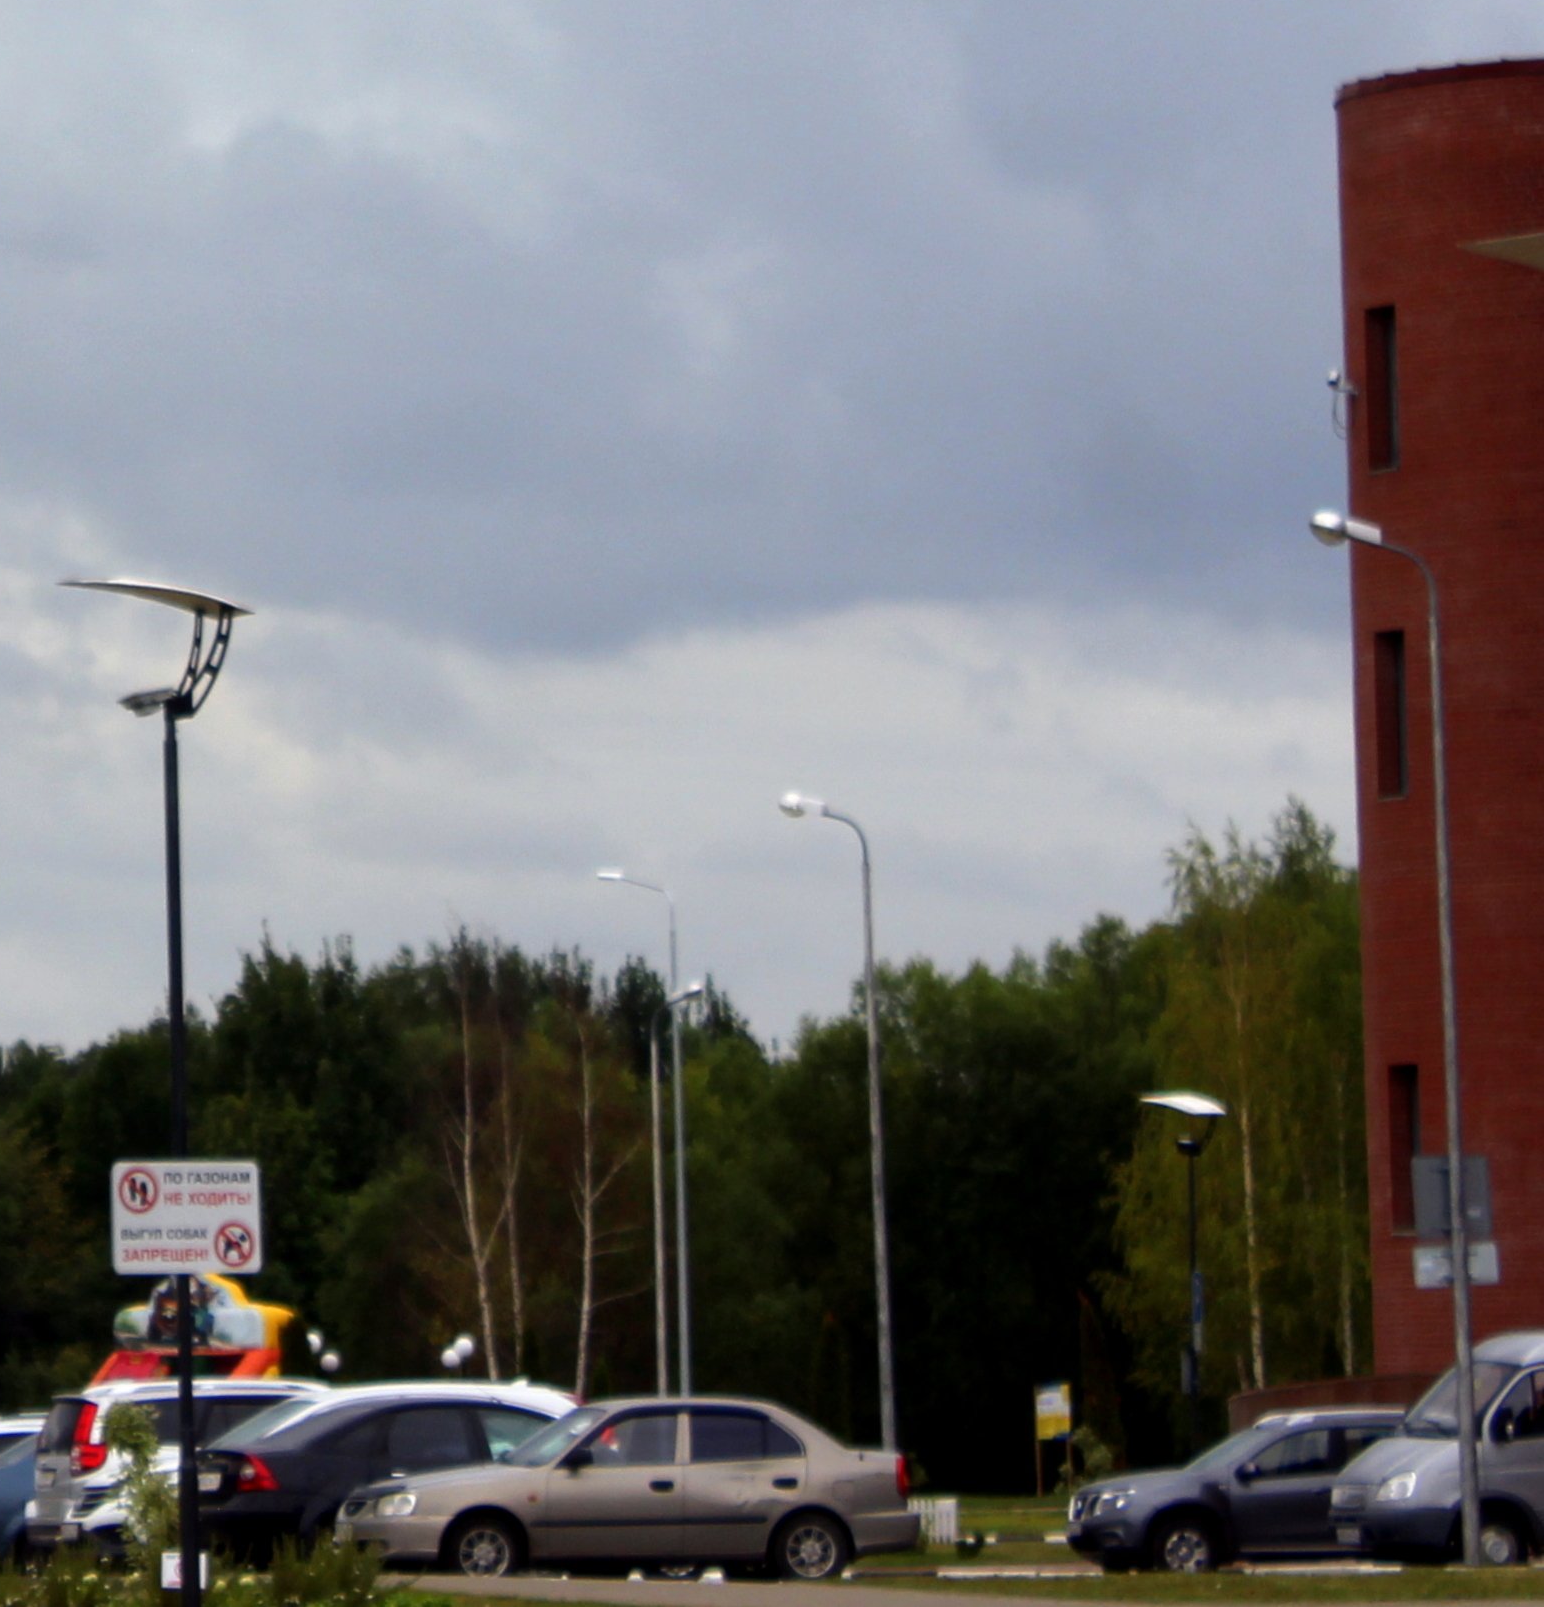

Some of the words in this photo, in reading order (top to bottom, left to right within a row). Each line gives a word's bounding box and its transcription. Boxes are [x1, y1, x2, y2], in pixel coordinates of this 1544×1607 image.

[164, 1172, 183, 1185] ПО
[188, 1172, 250, 1184] ГАЗОНАМ
[164, 1192, 183, 1206] НЕ
[188, 1192, 251, 1207] ХОДИТЬ!
[166, 1228, 208, 1240] СОБАК
[122, 1249, 209, 1263] ЗАПРЕЩЕН!
